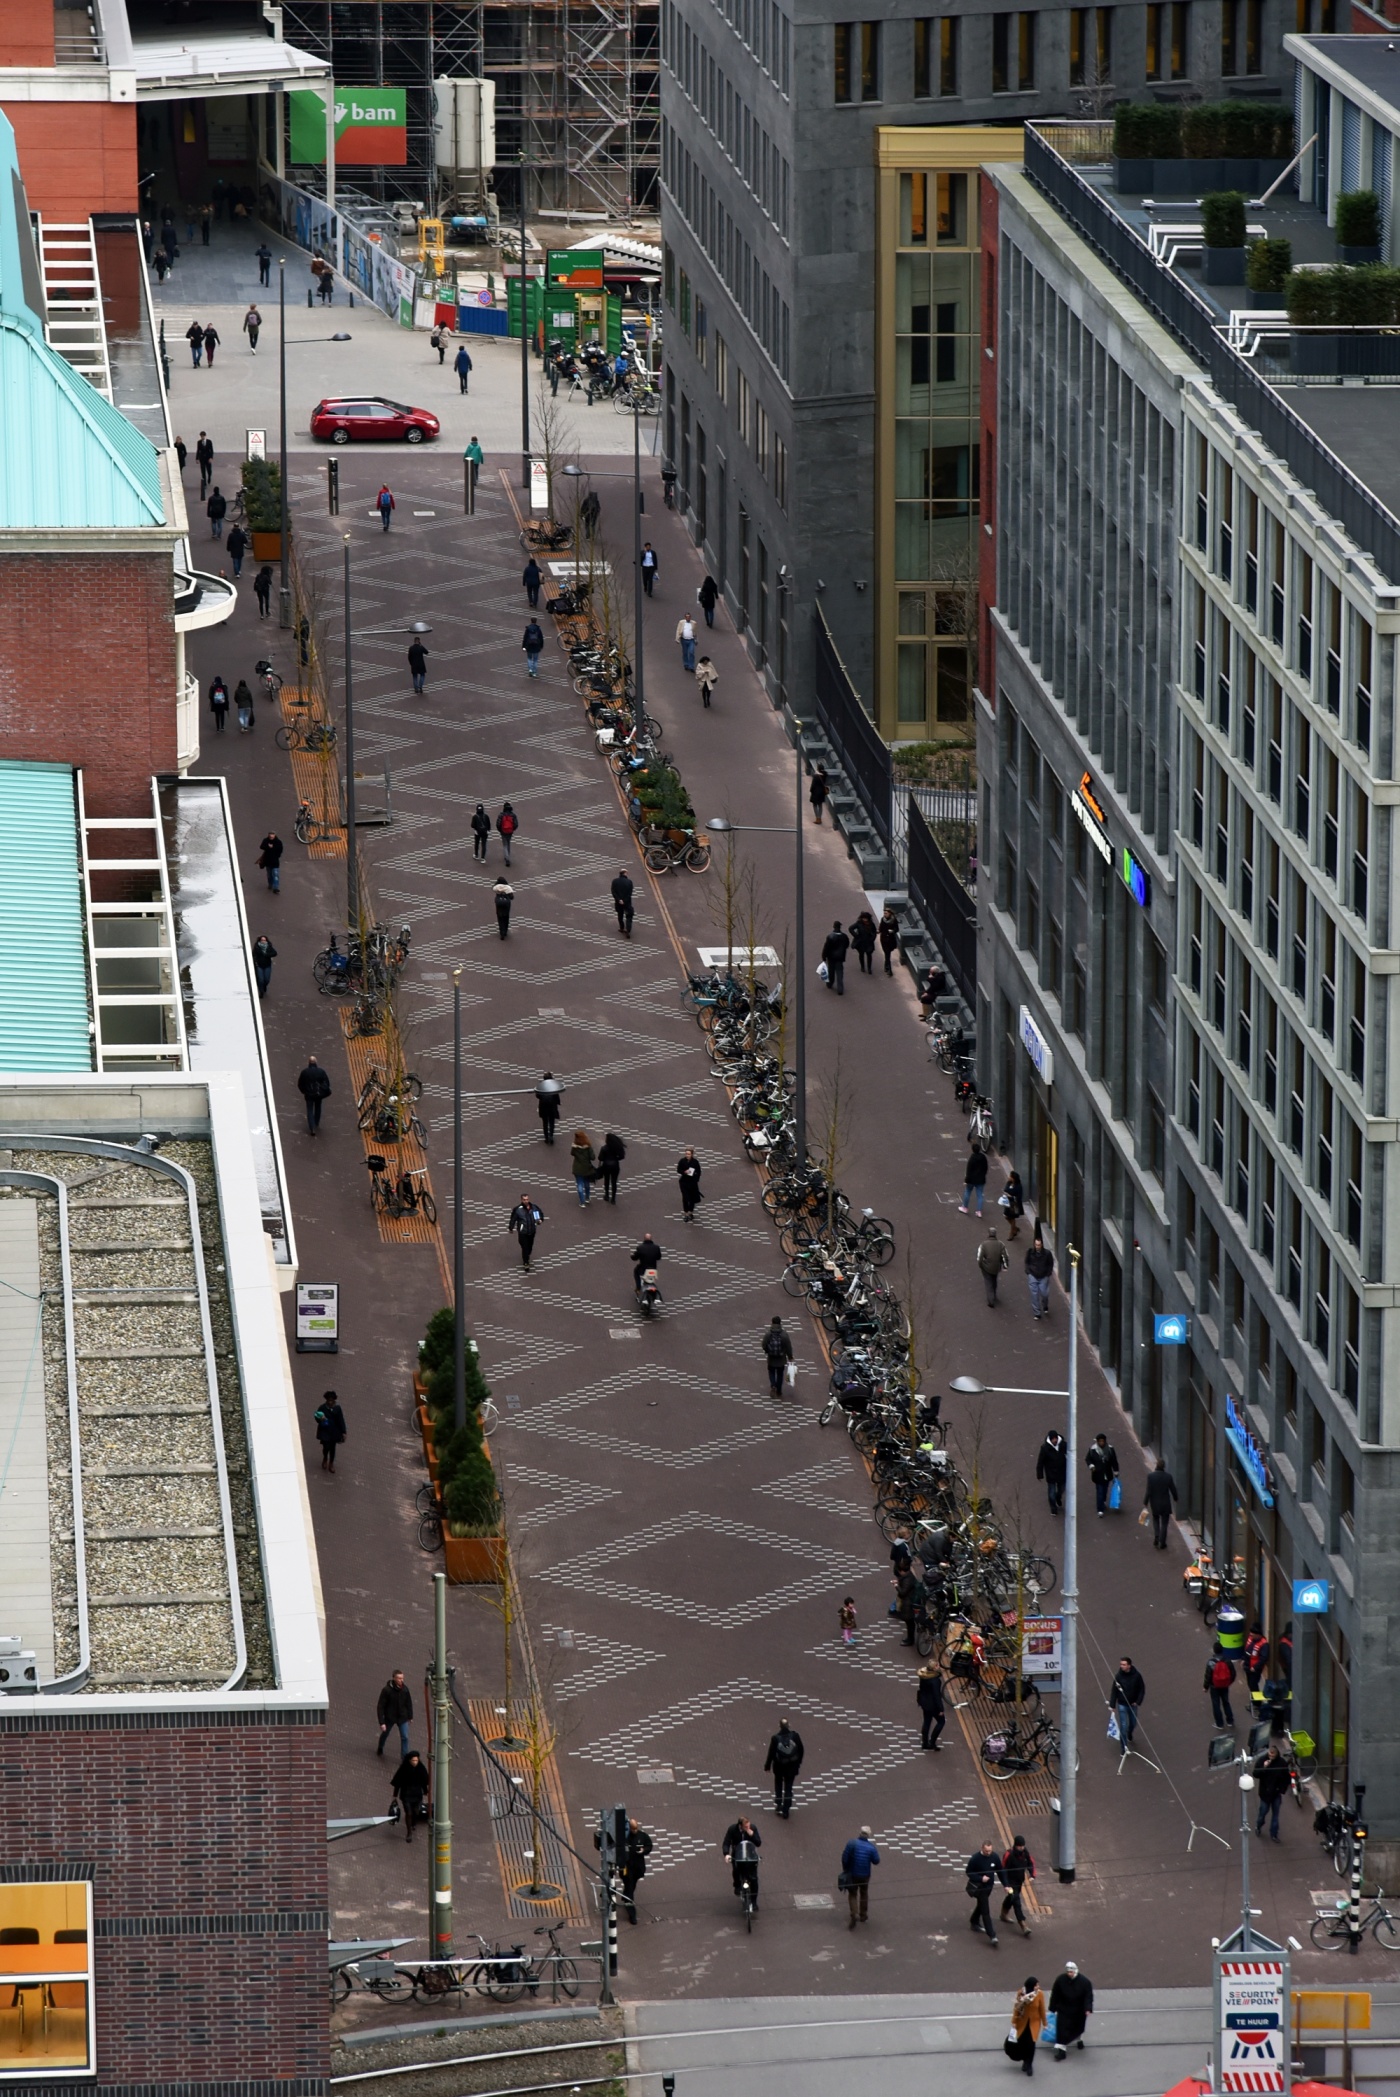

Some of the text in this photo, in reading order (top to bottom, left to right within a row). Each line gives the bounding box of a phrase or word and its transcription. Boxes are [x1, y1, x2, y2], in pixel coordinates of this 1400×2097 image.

[351, 102, 396, 121] bam
[1023, 1621, 1058, 1630] BONUS
[1247, 2018, 1270, 2026] HUUR
